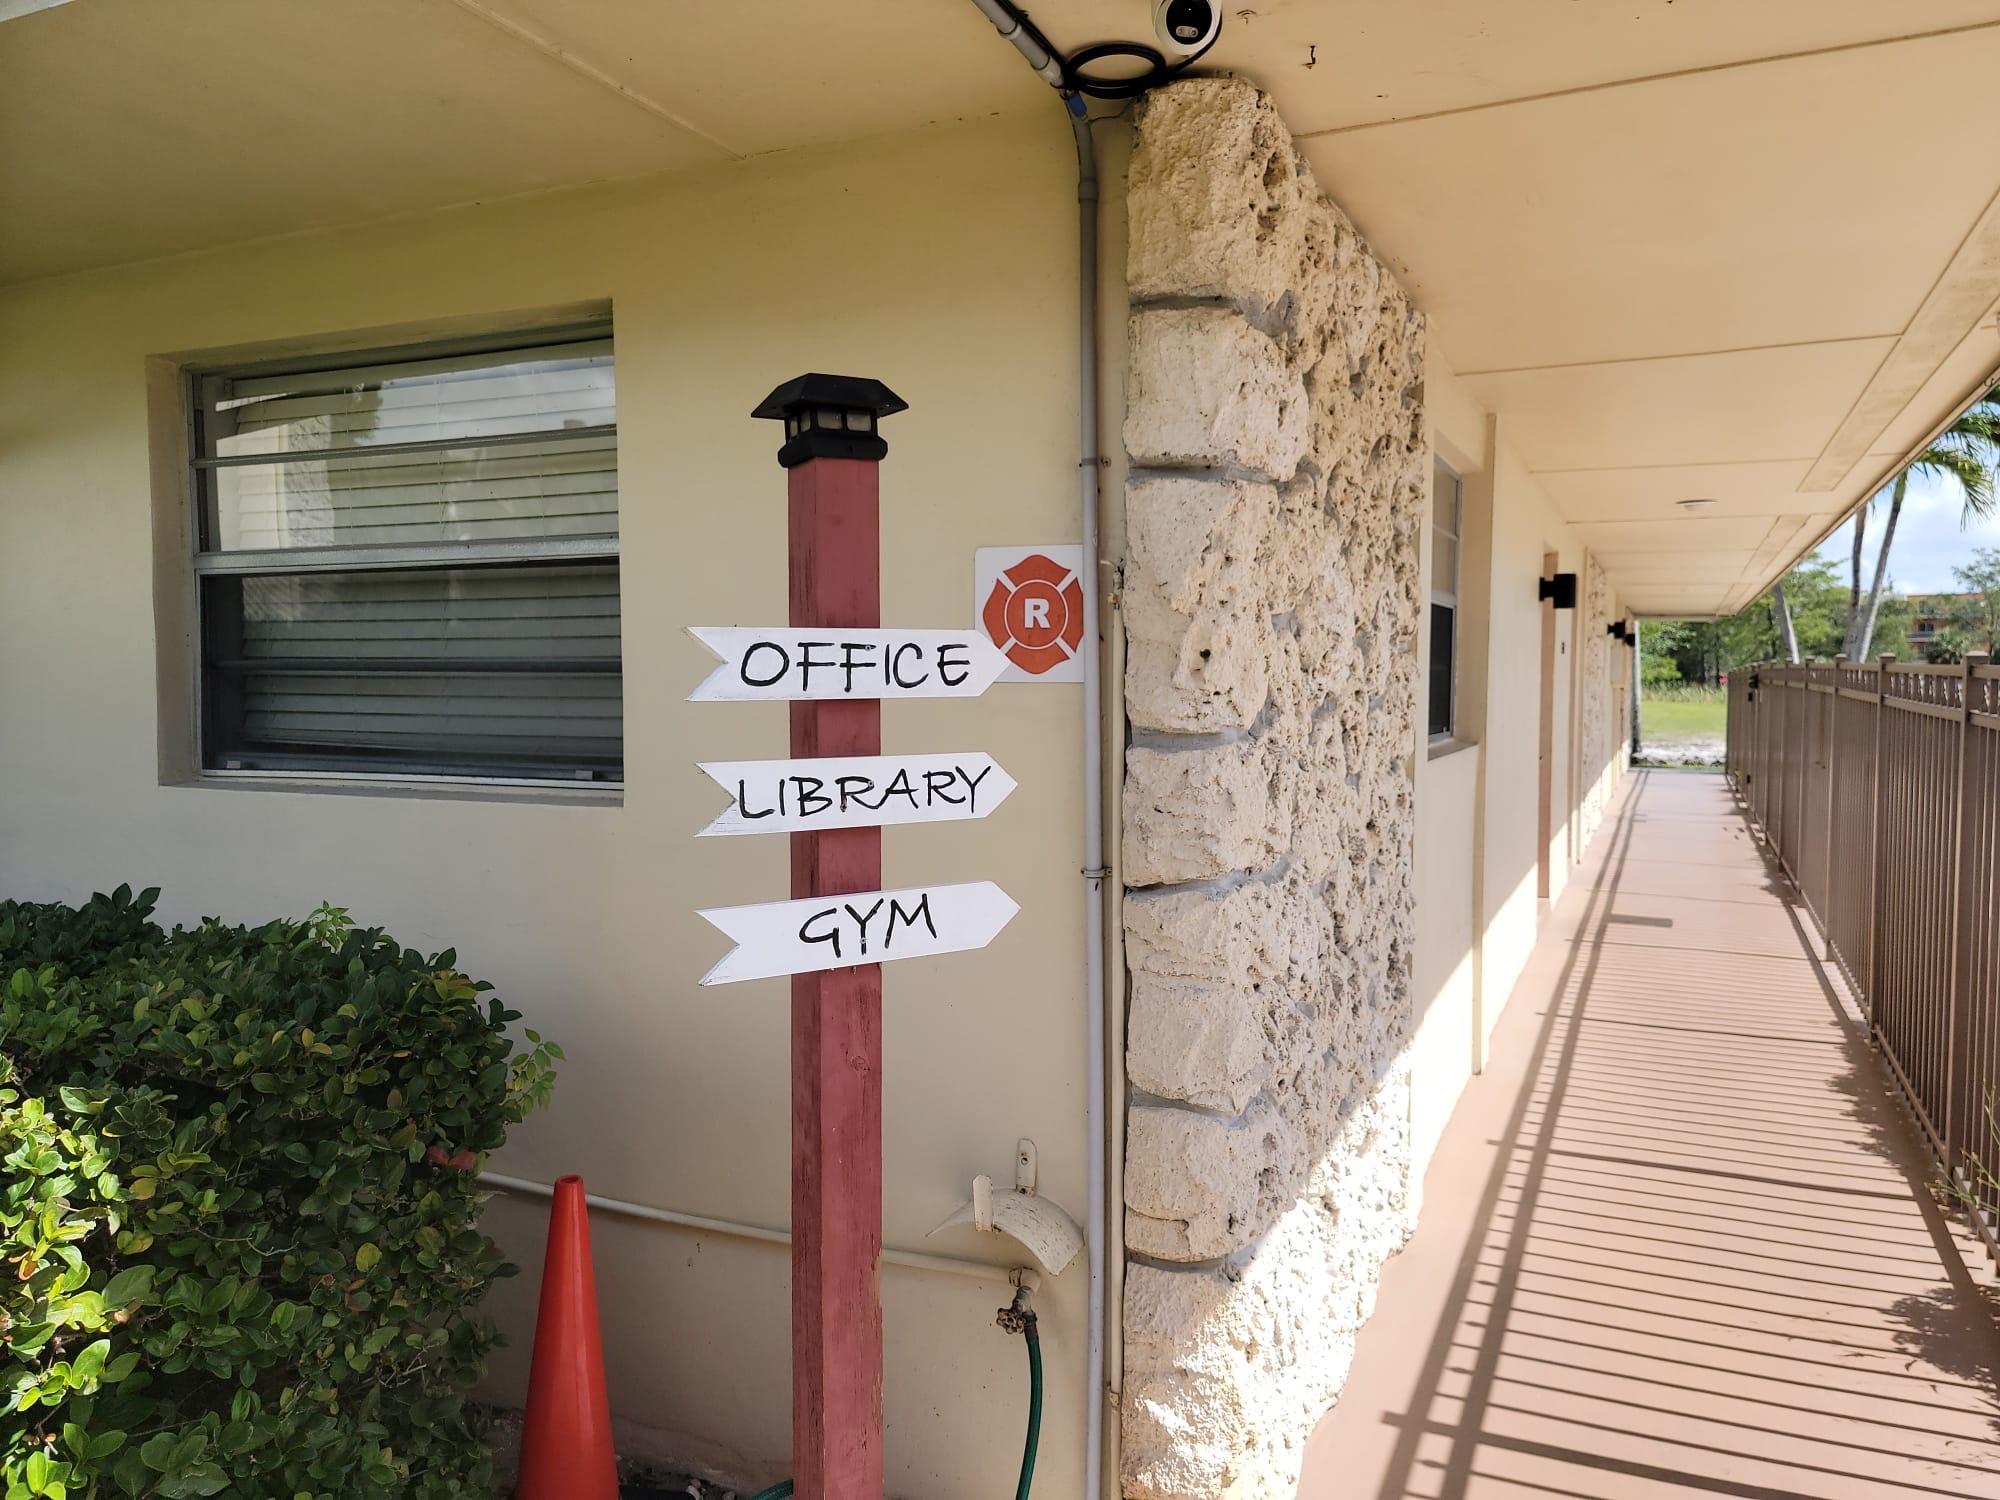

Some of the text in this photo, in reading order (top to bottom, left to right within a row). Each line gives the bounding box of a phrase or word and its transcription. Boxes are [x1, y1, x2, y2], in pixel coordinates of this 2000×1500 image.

[1024, 598, 1051, 629] R
[740, 641, 972, 693] OFFICE
[738, 765, 992, 819] LIBRARY
[798, 893, 938, 959] GYM
